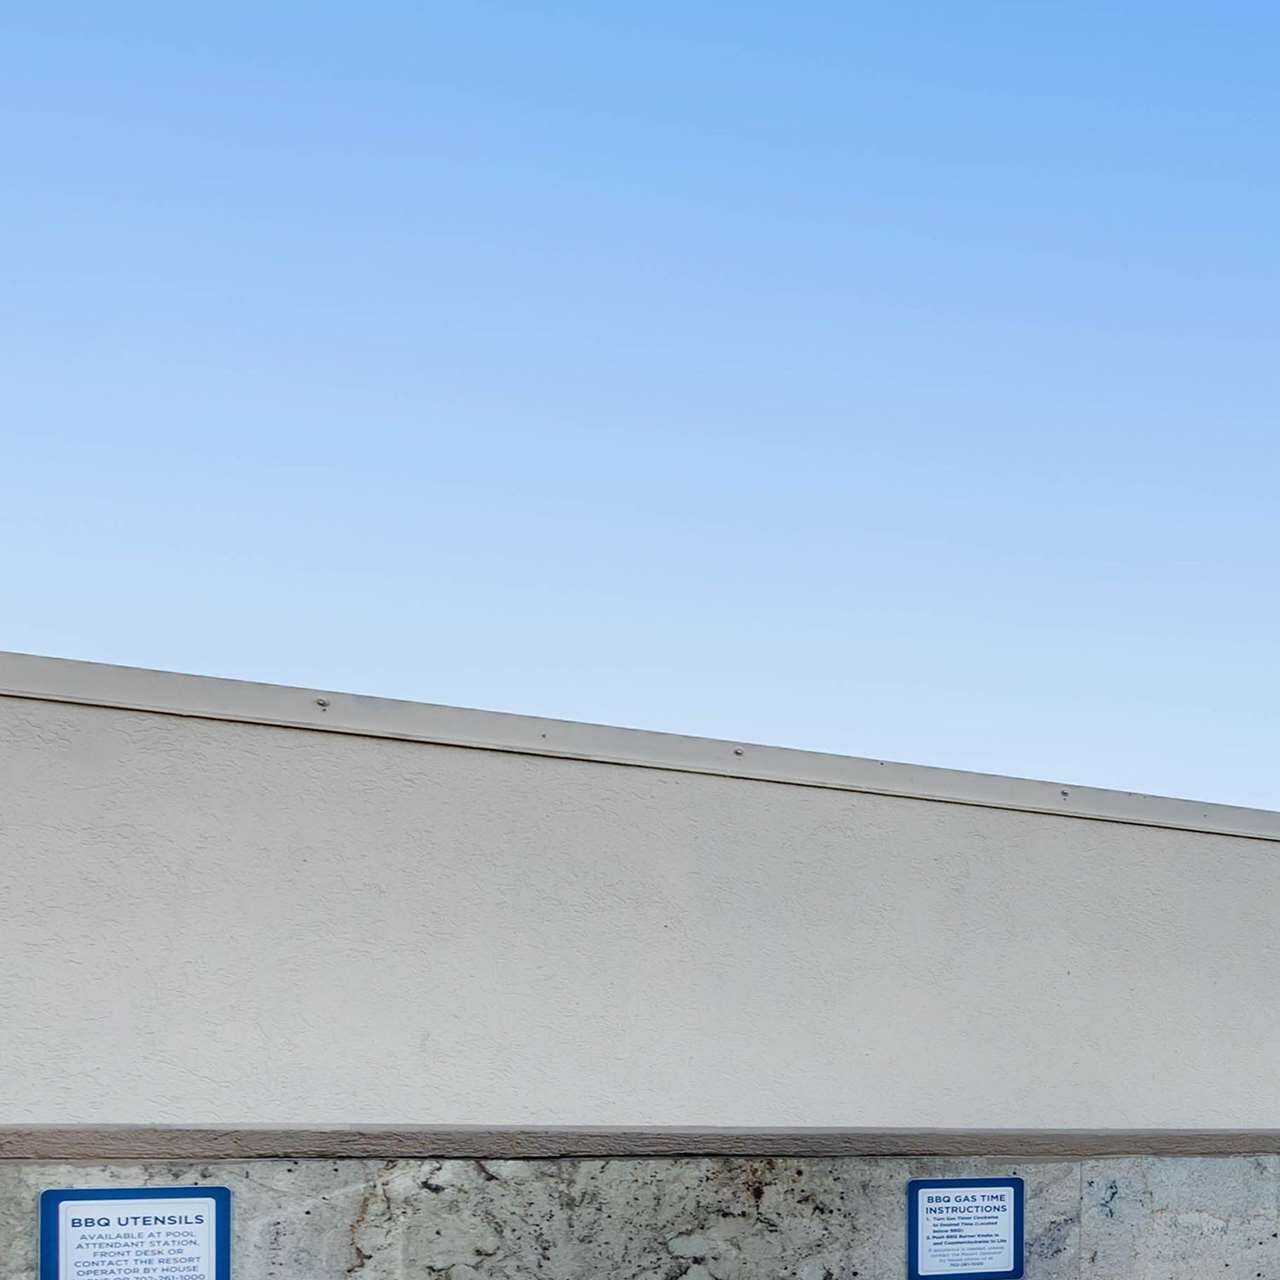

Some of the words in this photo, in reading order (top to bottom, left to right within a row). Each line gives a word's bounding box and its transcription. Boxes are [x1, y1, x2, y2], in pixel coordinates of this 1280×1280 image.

[927, 1195, 951, 1204] BBQ
[954, 1194, 977, 1203] GAS
[980, 1194, 1006, 1202] TIME
[926, 1204, 1008, 1214] INSTRUCTIONS
[71, 1217, 111, 1227] BBQ
[117, 1215, 205, 1227] UTENSILS
[80, 1232, 144, 1240] AVAILABLE
[76, 1241, 145, 1249] ATTENDANT
[93, 1250, 131, 1258] FRONT
[74, 1260, 129, 1268] CONTACT
[158, 1256, 201, 1264] RESORT
[76, 1268, 140, 1277] OPERATOR
[161, 1265, 199, 1273] HOUSE
